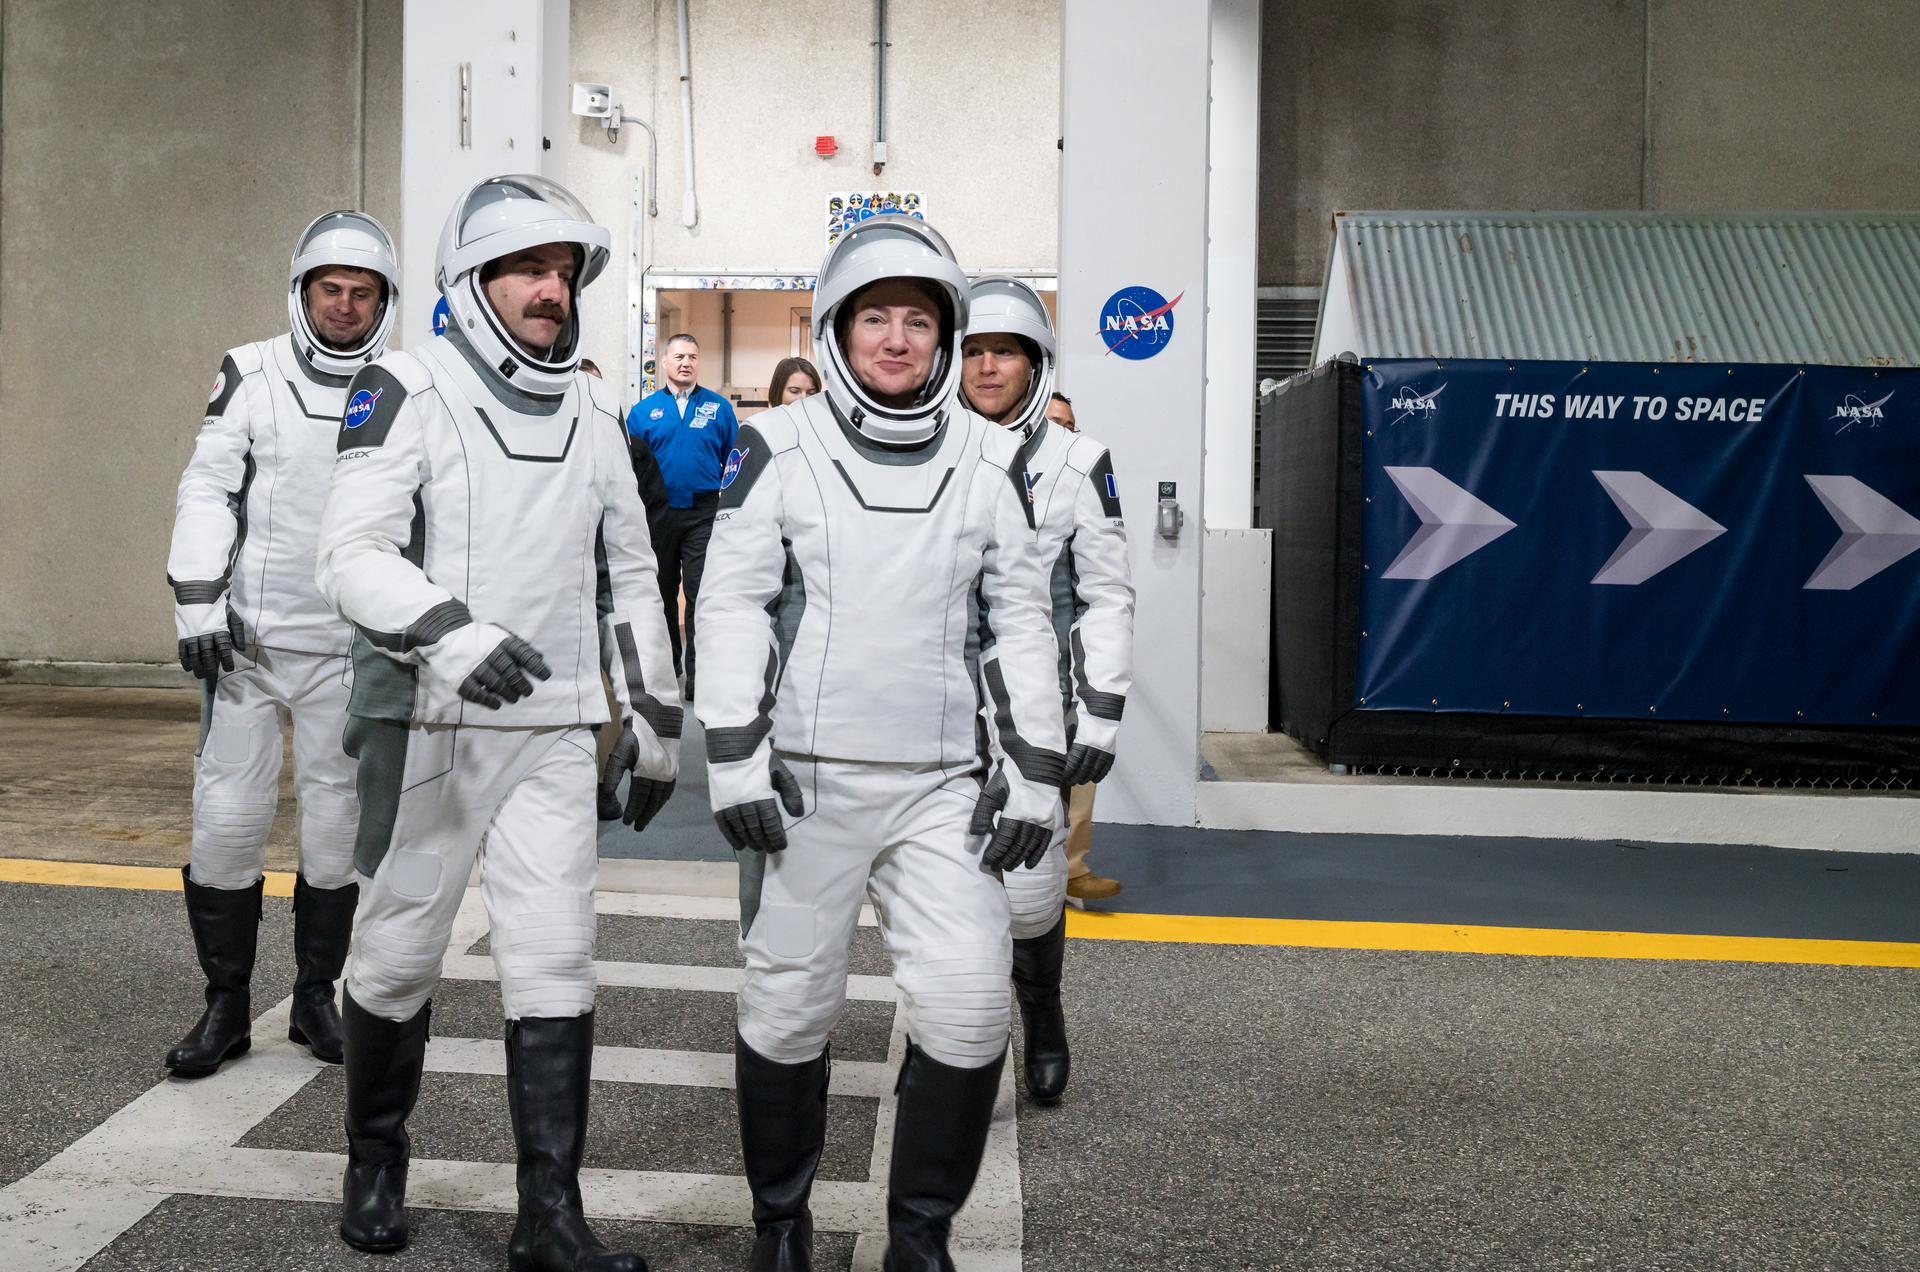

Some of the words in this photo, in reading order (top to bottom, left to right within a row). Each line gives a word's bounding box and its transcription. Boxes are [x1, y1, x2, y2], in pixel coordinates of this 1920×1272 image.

[1105, 315, 1170, 331] NASA
[348, 403, 371, 415] NASA
[1392, 398, 1437, 410] NASA
[1495, 394, 1556, 419] THIS
[1564, 394, 1626, 420] WAY
[1632, 396, 1668, 421] TO
[1674, 398, 1766, 423] SPACE
[1836, 405, 1884, 418] NASA
